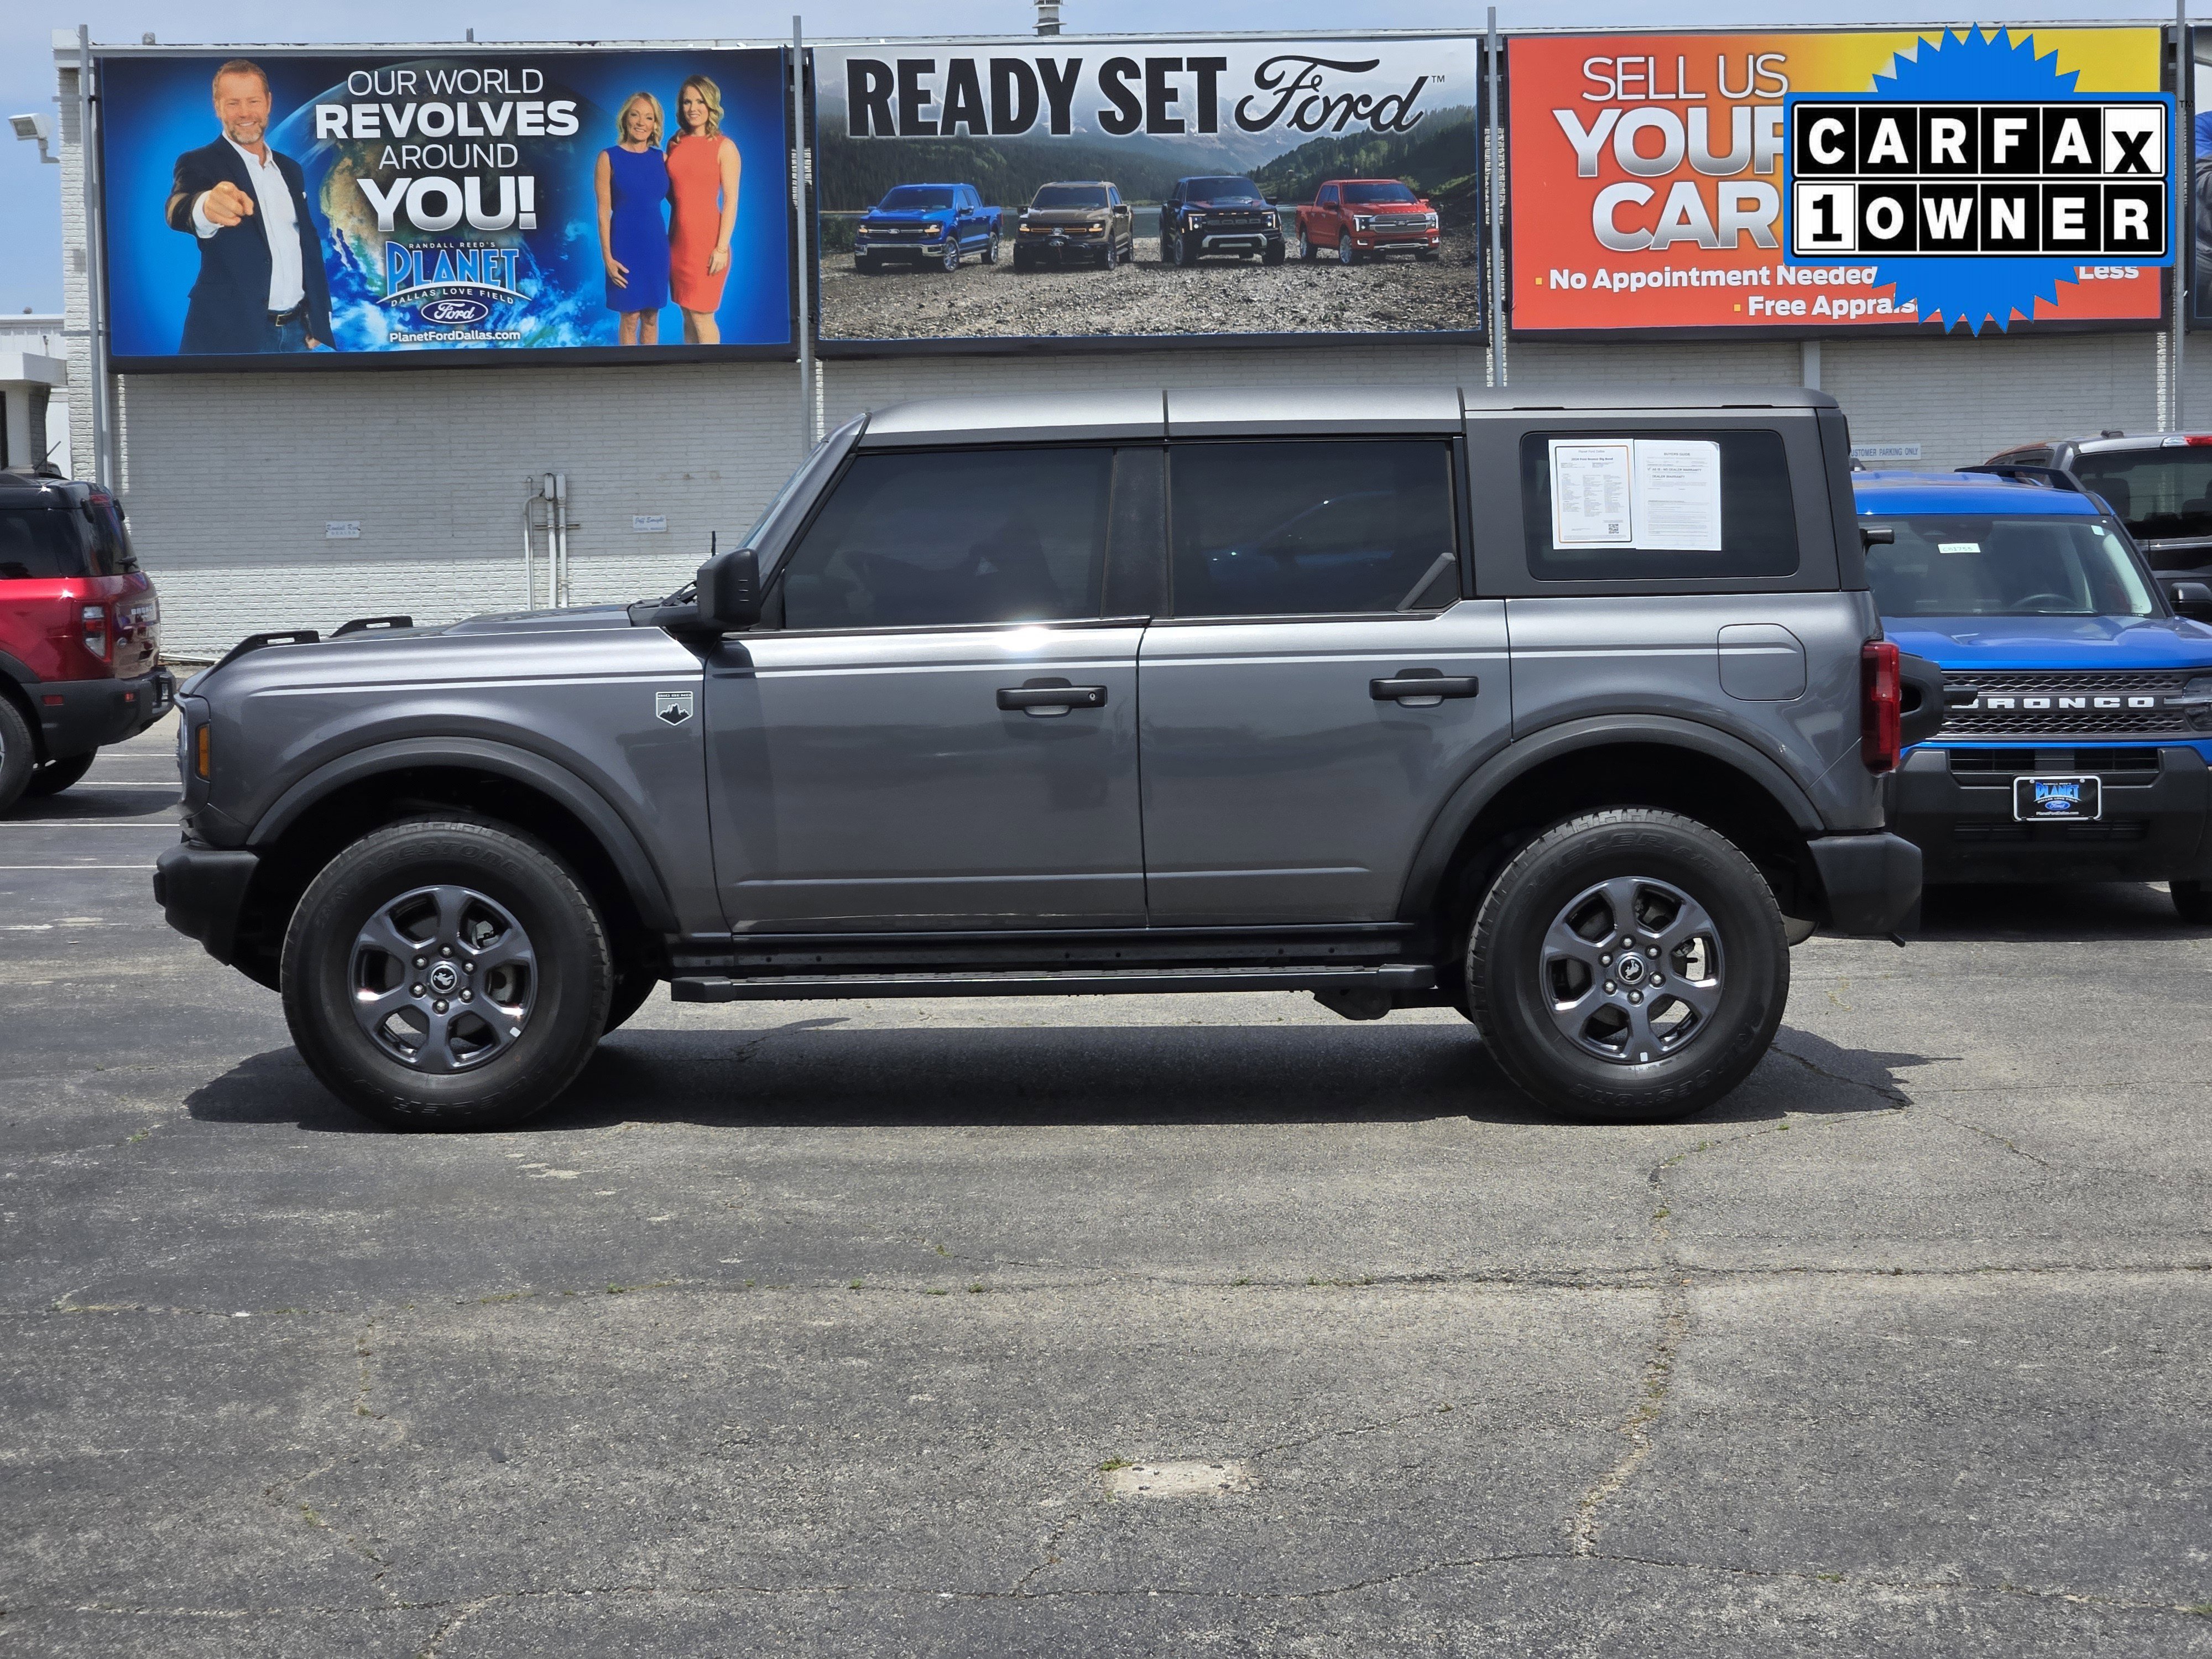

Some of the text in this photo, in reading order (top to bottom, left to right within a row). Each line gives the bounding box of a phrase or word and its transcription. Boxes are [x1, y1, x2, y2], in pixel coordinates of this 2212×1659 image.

[347, 69, 544, 96] OUR WORLD
[1582, 54, 1789, 101] SELL US
[847, 57, 1083, 138] READY
[1098, 56, 1227, 136] SET
[1235, 55, 1428, 134] Ford
[316, 100, 579, 139] REVOLVES
[379, 143, 518, 170] AROUND
[356, 175, 537, 232] YOU!
[1593, 180, 1779, 252] CAR
[385, 241, 519, 297] PLANET
[1550, 265, 1877, 293] No Appointment Needed
[2079, 266, 2140, 279] Less
[390, 289, 436, 307] DALLAS
[479, 290, 514, 305] FIELD
[434, 302, 476, 320] Ford
[1748, 295, 1806, 316] Free
[390, 330, 521, 342] PlanetFordDallas.com
[1850, 447, 1918, 457] USTOMER PARKING ONLY
[2036, 782, 2079, 800] PLANET
